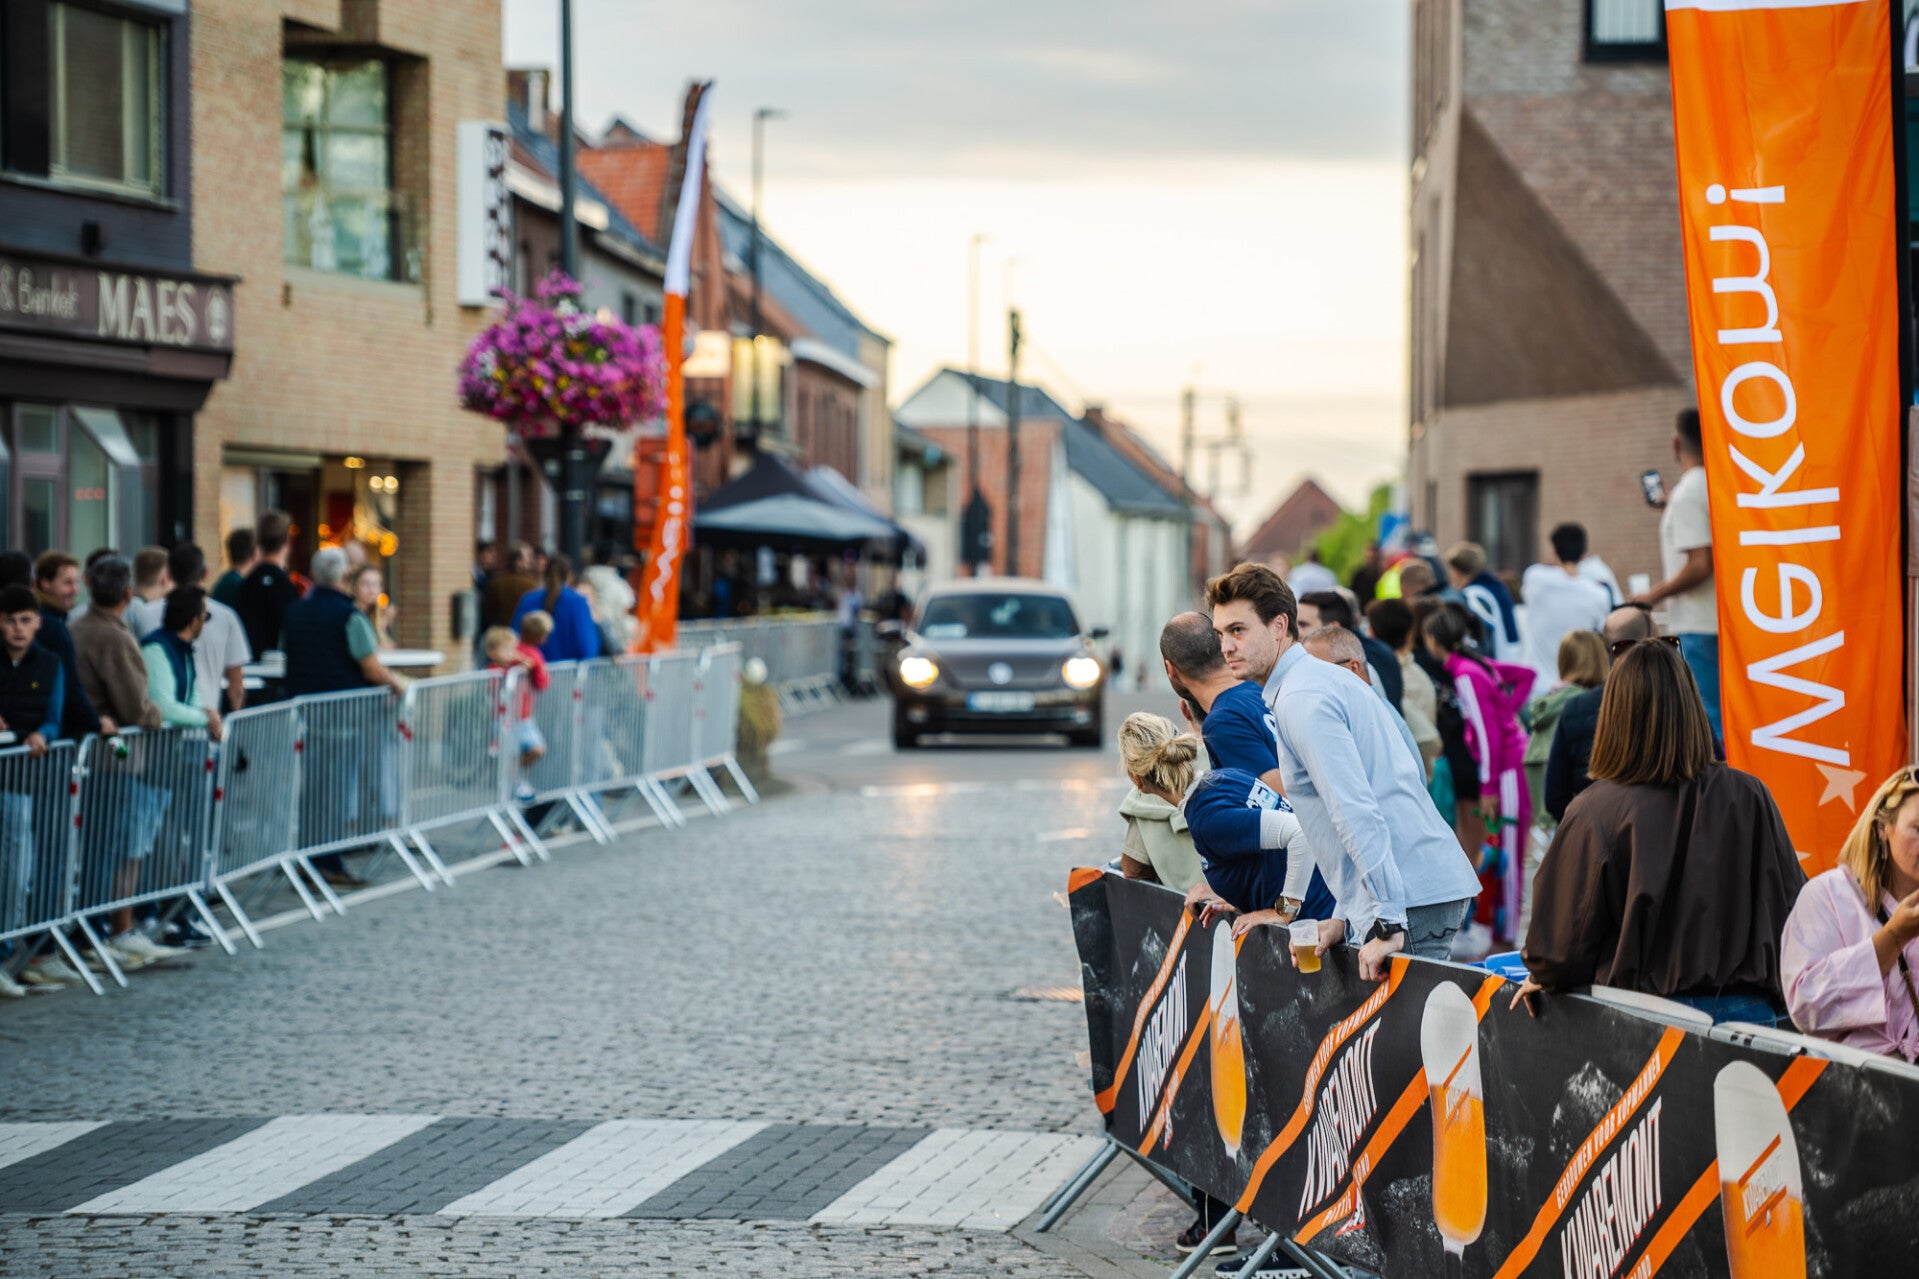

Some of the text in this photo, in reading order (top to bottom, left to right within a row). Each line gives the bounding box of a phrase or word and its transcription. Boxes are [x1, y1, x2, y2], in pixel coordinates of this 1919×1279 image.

[97, 271, 198, 346] MAES
[1704, 182, 1851, 768] Welkom!
[1593, 1112, 1616, 1154] VOOR
